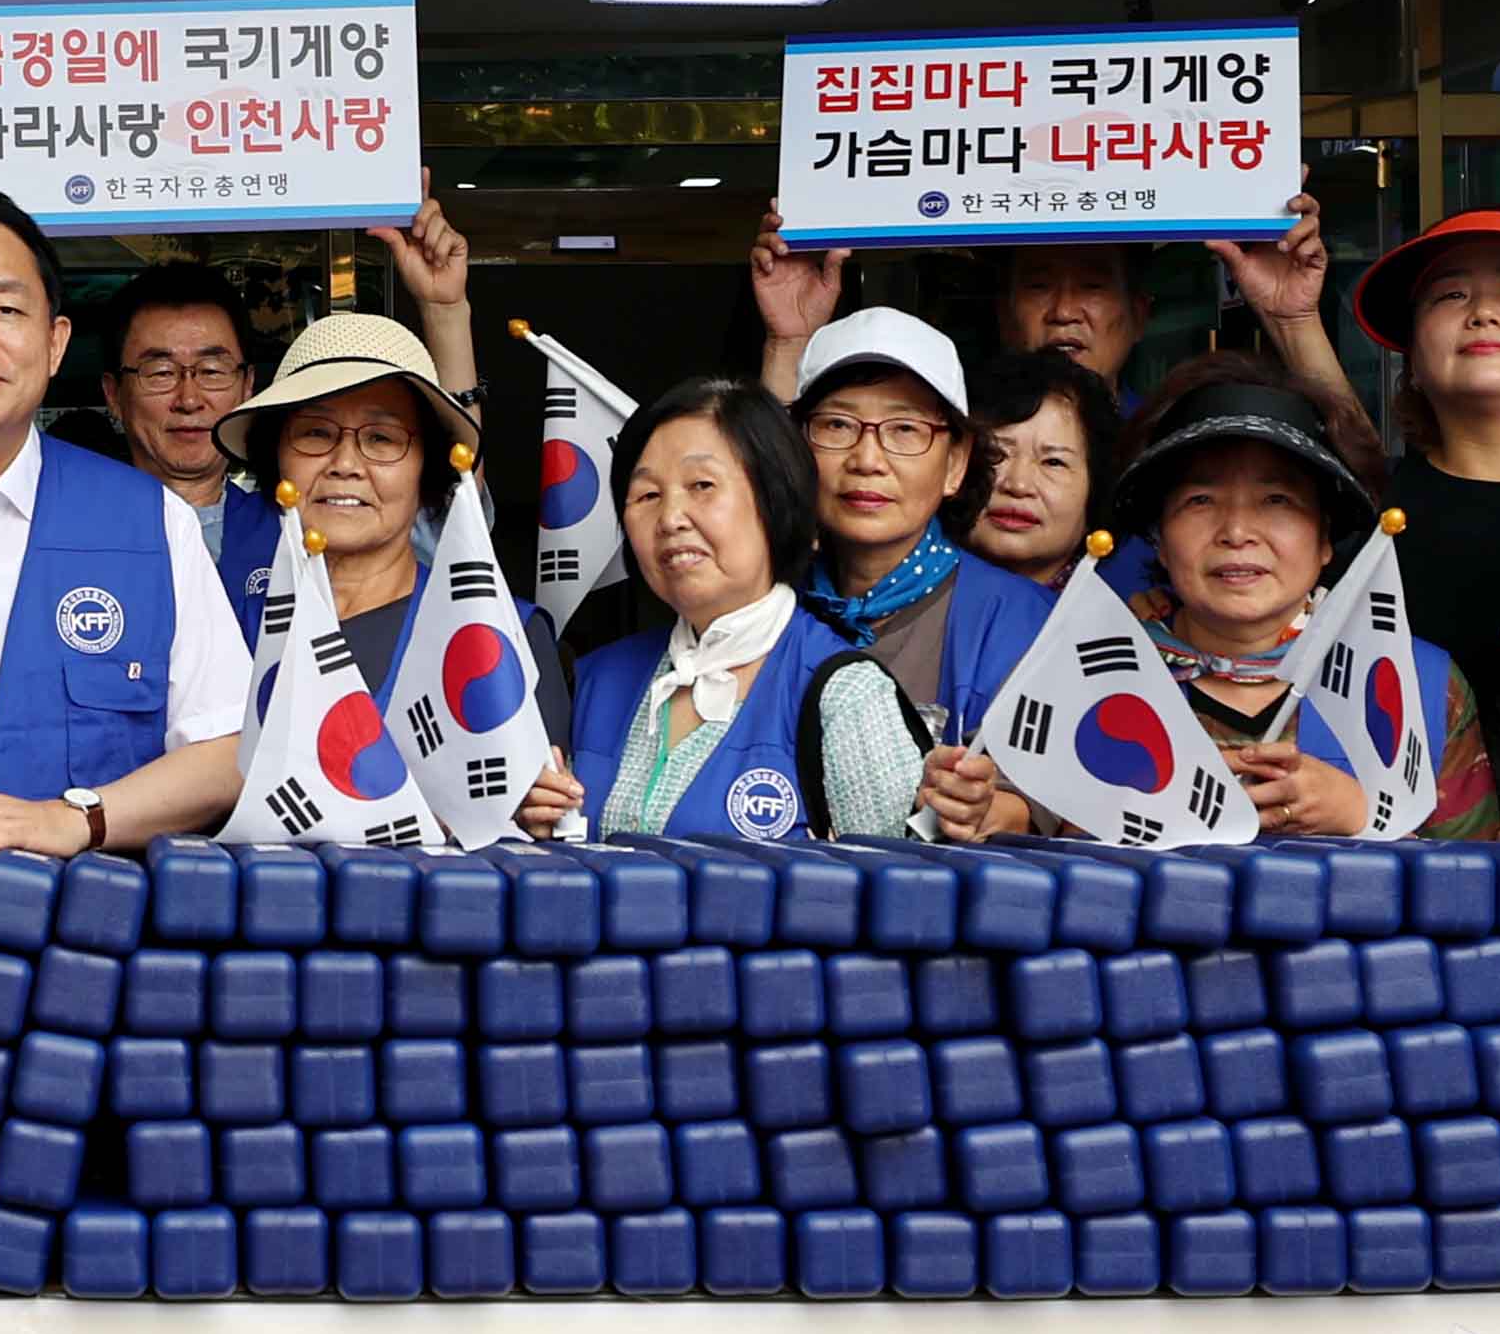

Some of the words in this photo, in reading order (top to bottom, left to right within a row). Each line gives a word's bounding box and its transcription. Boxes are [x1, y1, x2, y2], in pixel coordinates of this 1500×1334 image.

[185, 22, 390, 80] 국기게양
[815, 60, 1028, 113] 집집마다
[1050, 52, 1270, 104] 국기게양
[185, 97, 392, 155] 인천사랑
[814, 125, 1027, 178] 가슴마다
[1050, 119, 1270, 171] 나라사랑
[106, 172, 289, 200] 한국자유총연맹
[961, 189, 1156, 213] 한국자유총연맹
[71, 612, 112, 631] KFF
[743, 795, 786, 818] KFF
